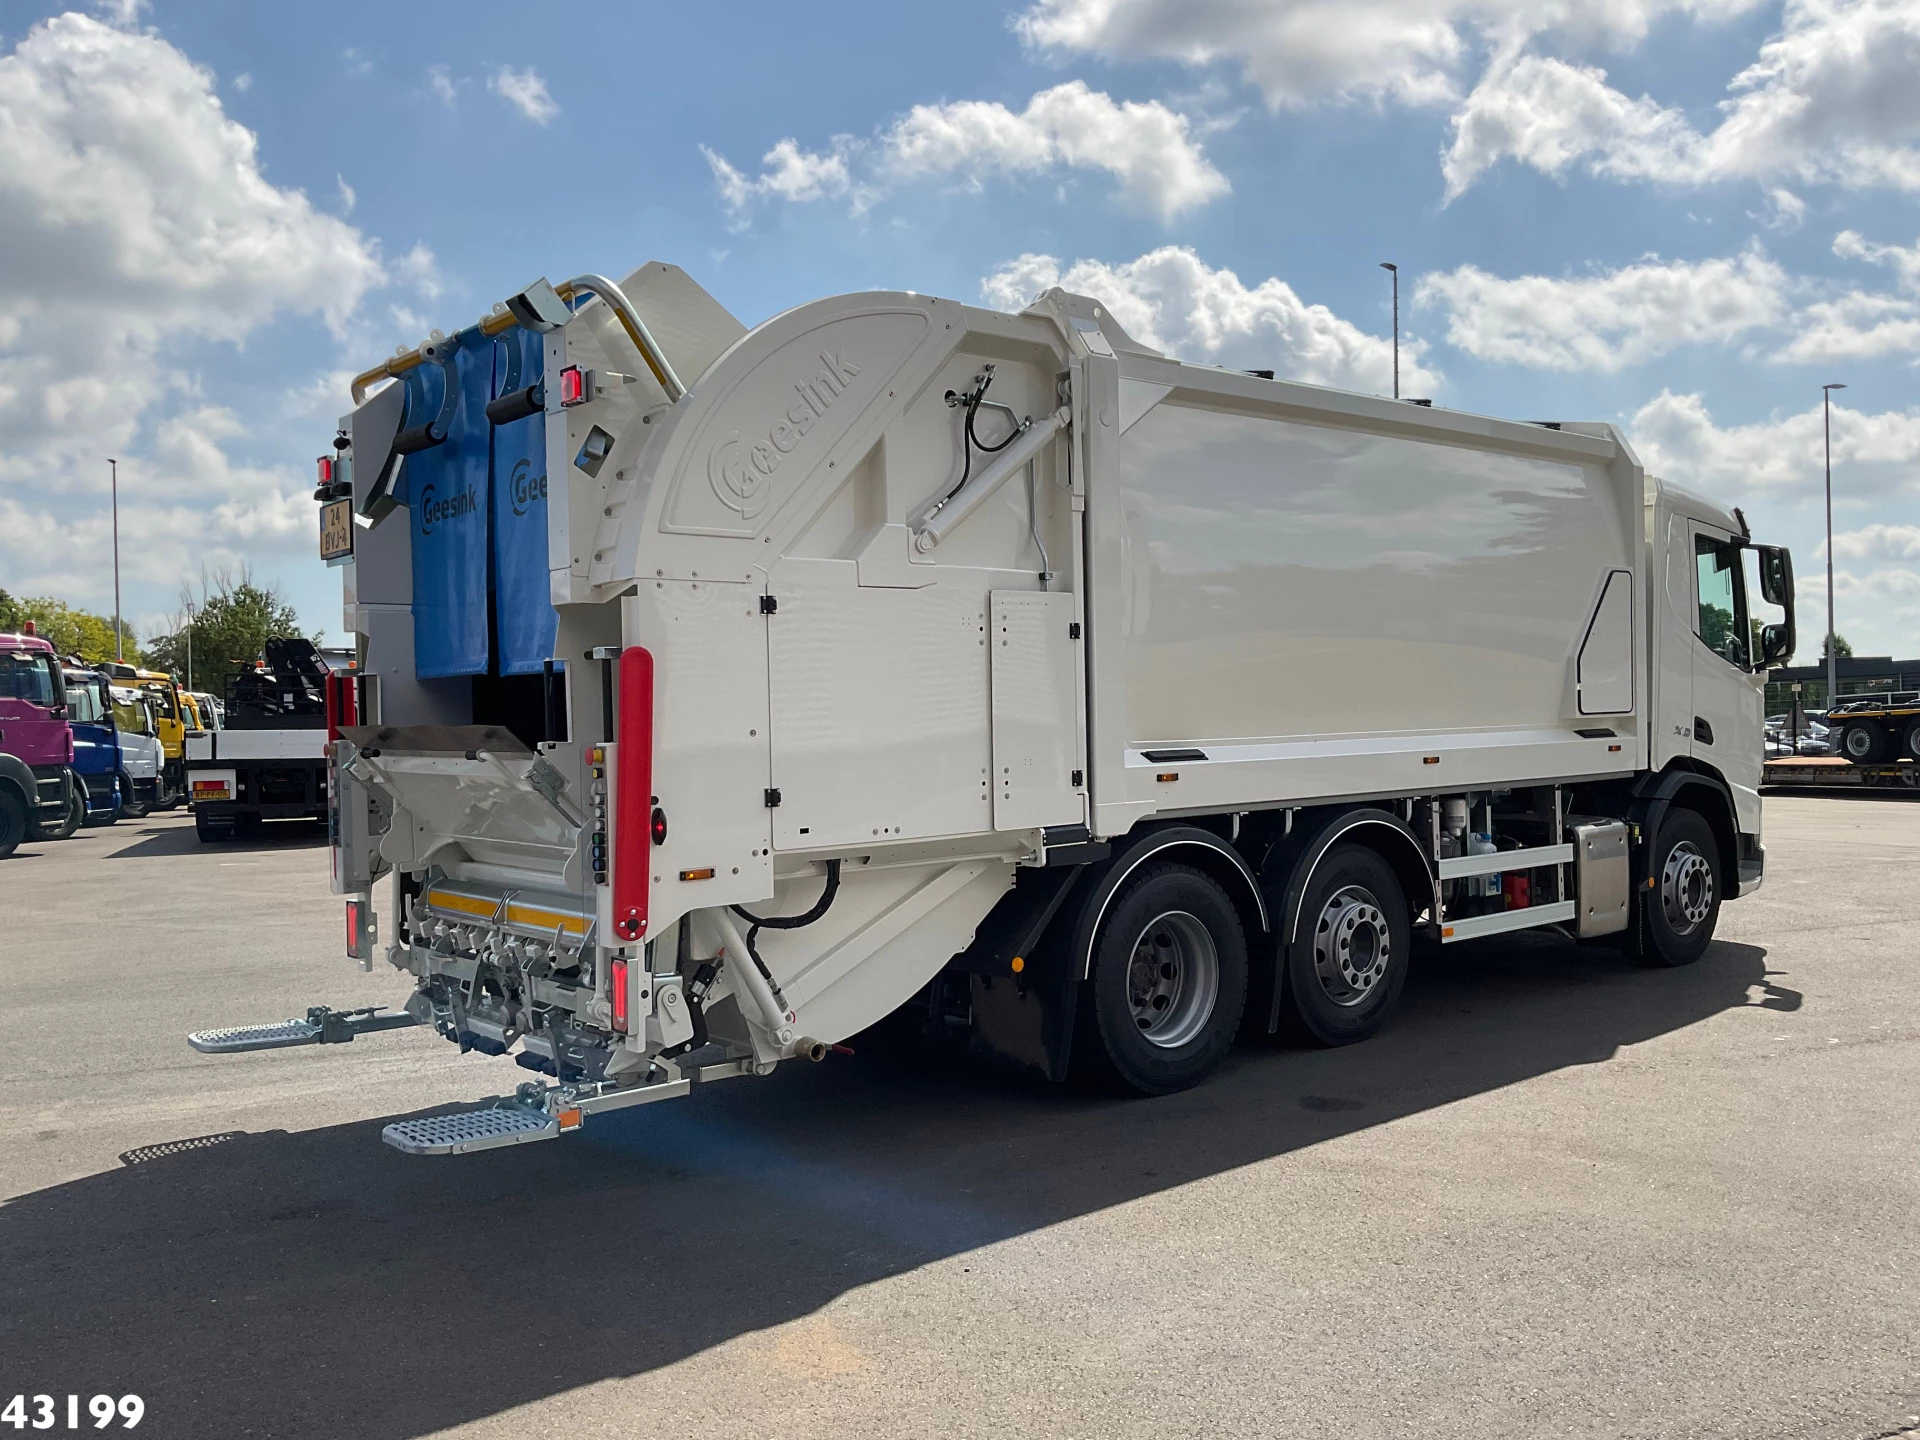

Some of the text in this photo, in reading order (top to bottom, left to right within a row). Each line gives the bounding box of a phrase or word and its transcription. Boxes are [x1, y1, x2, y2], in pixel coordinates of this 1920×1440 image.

[708, 346, 861, 520] Geesink
[330, 506, 340, 527] 24
[421, 484, 476, 535] Geesink
[325, 528, 347, 551] BVJ-4
